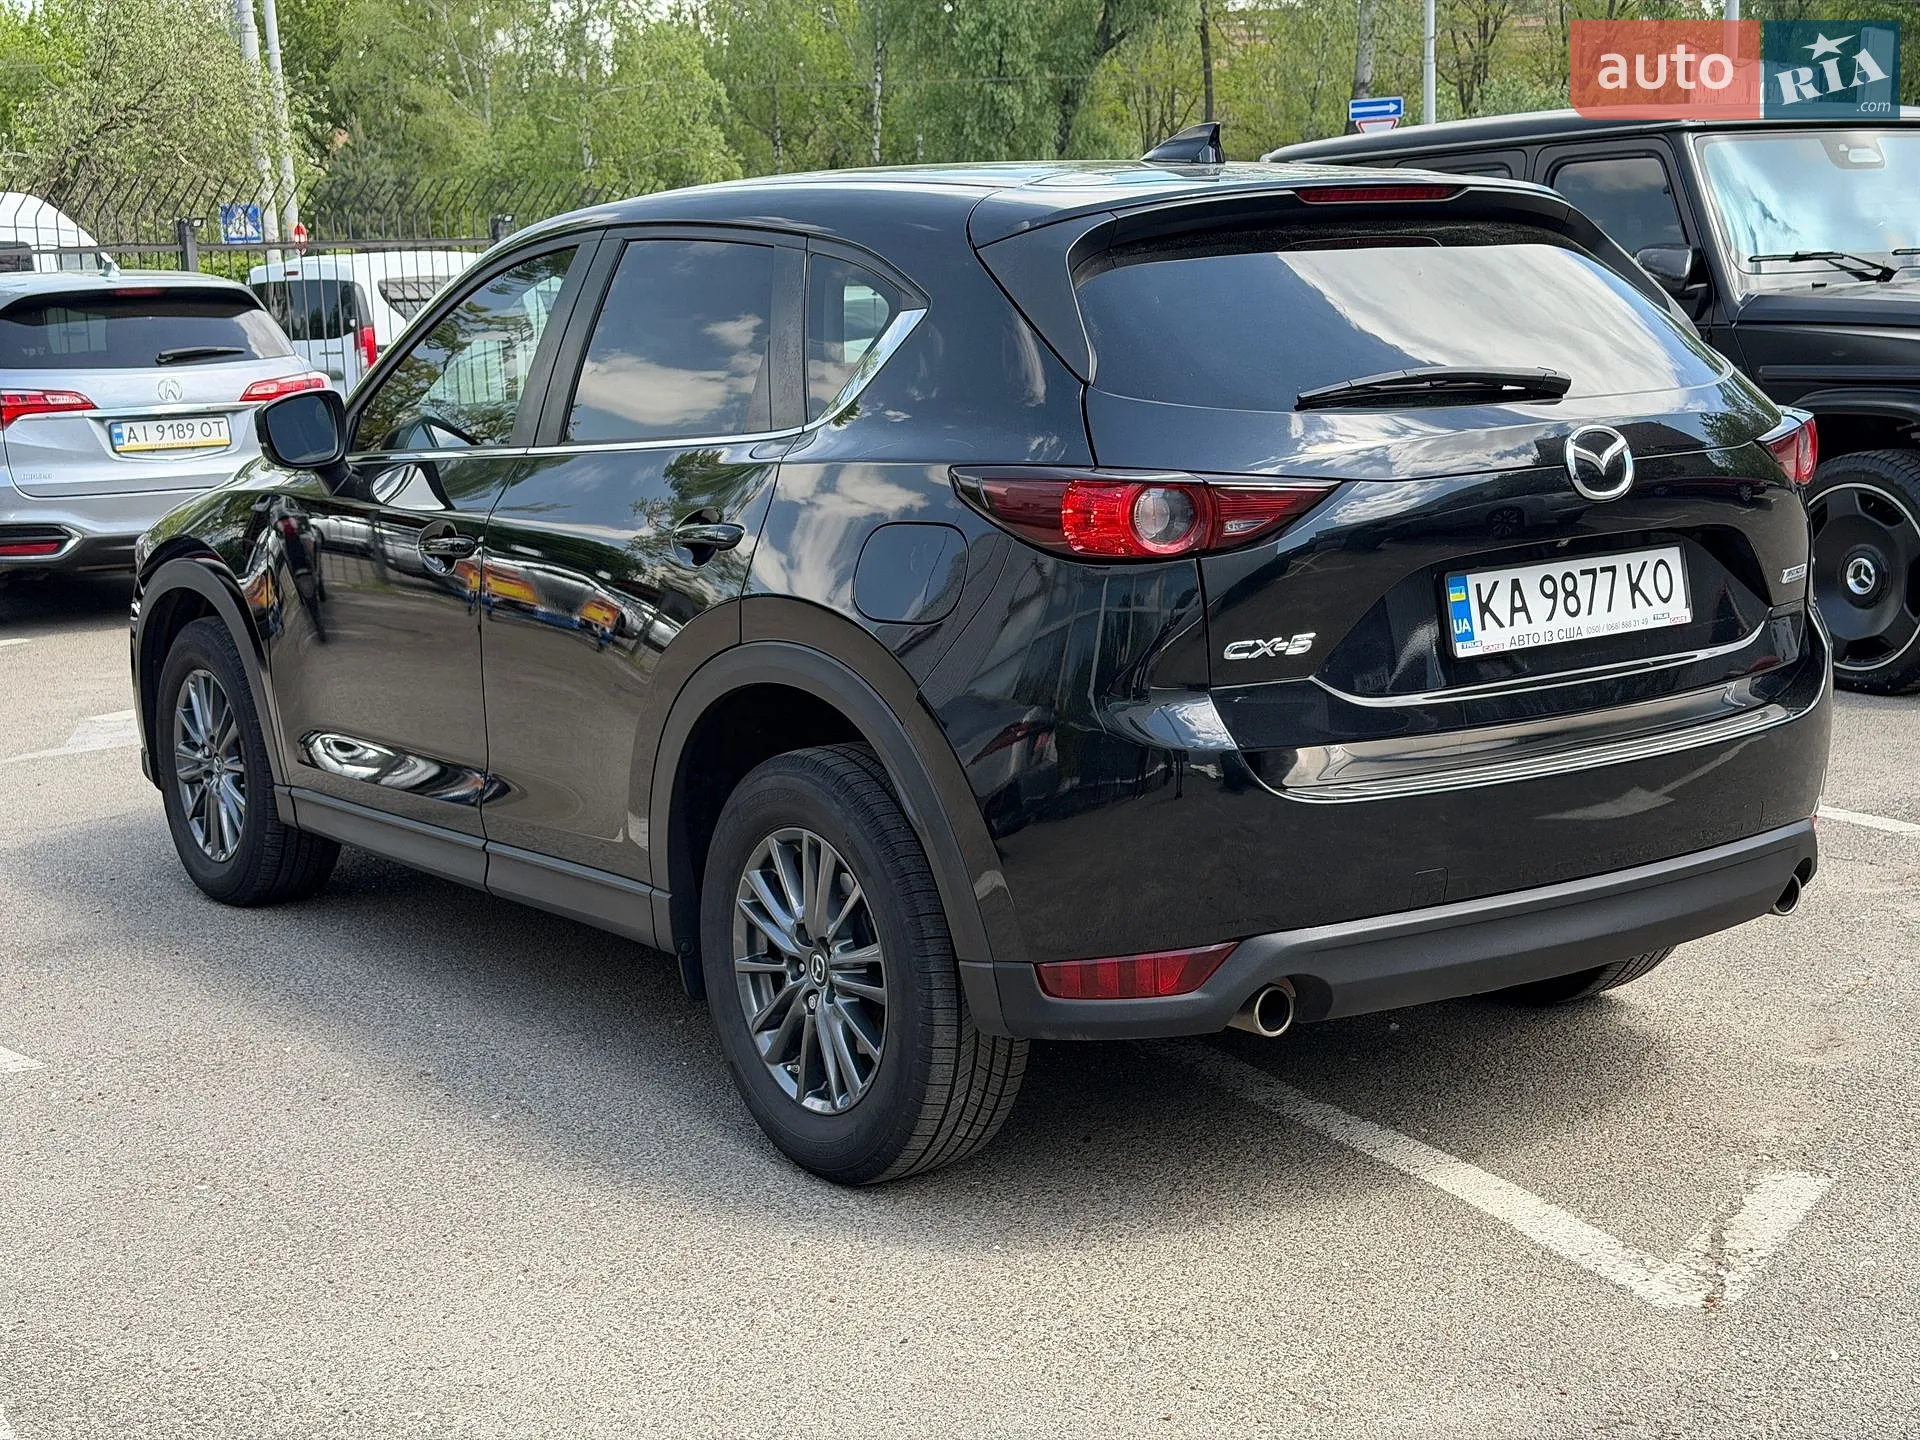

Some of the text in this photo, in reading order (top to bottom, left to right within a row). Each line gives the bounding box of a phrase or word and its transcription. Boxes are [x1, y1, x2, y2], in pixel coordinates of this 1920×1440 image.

[127, 421, 224, 443] AI 9189 OT
[1475, 558, 1674, 631] KA 9877 KO
[1453, 618, 1471, 634] UA
[1509, 632, 1540, 648] АВТО
[1557, 626, 1583, 640] США
[1224, 632, 1317, 660] CX-5
